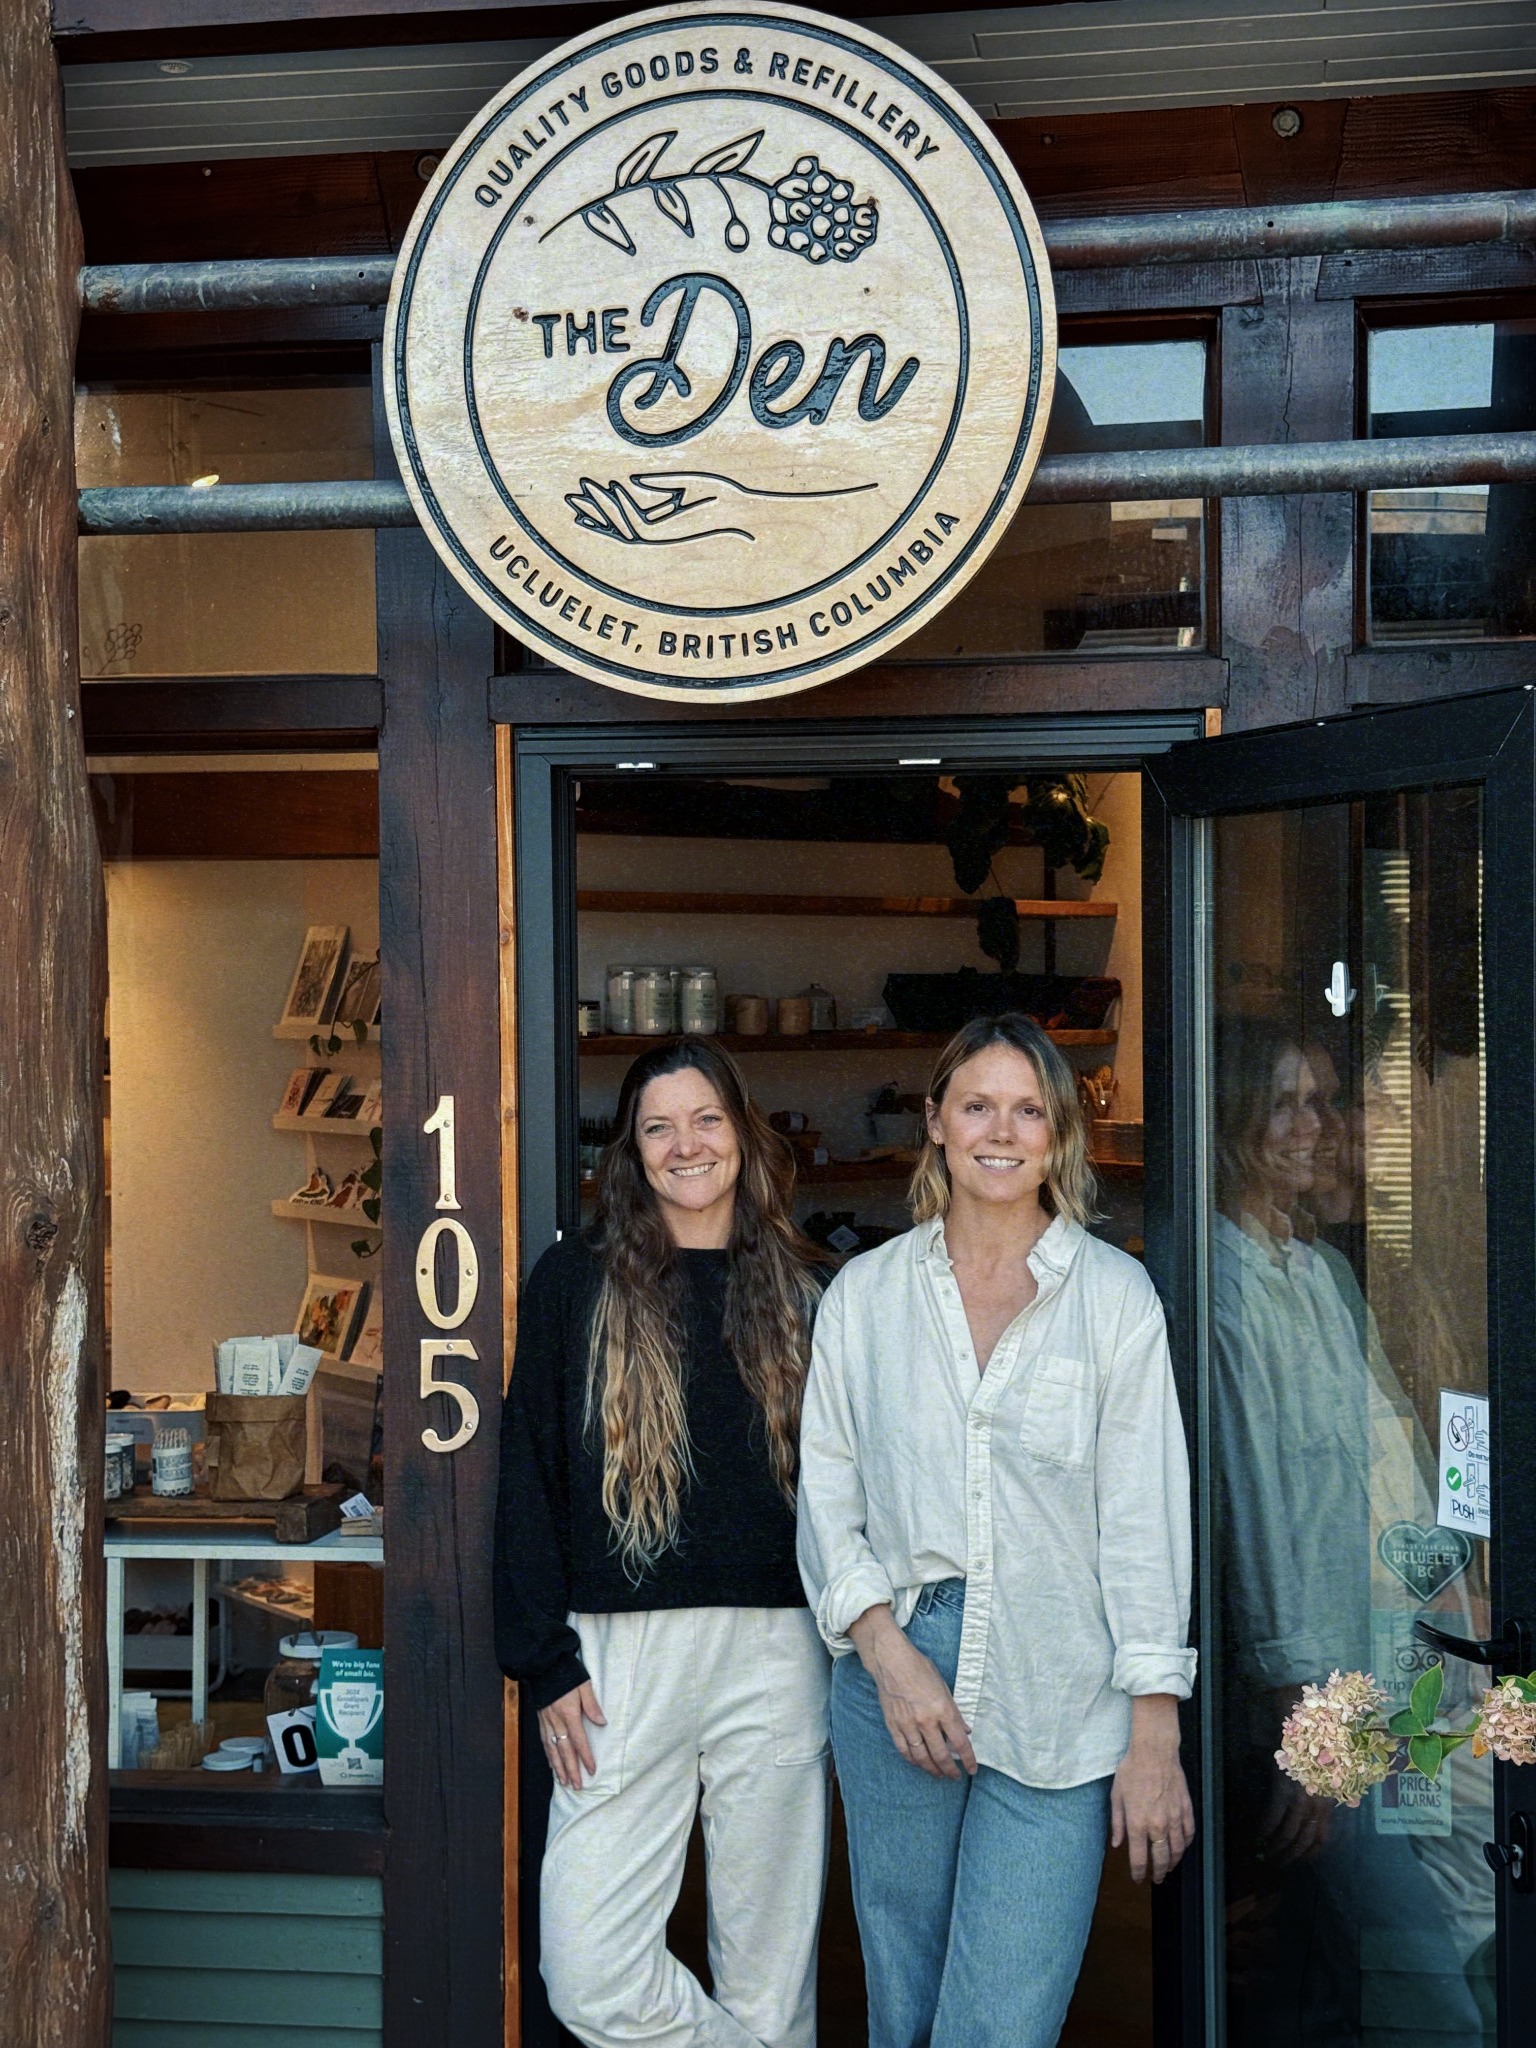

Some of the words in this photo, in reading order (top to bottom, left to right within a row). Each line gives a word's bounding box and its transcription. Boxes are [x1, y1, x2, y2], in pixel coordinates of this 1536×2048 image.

[474, 86, 594, 209] QUALITY
[601, 47, 720, 97] GOODS
[733, 48, 754, 75] &
[768, 52, 941, 163] REFILLERY
[532, 308, 631, 358] THE
[606, 272, 920, 448] Den
[490, 534, 642, 654] UCLUELET,
[658, 623, 798, 660] BRITISH
[810, 511, 960, 637] COLUMBIA
[1451, 1499, 1475, 1520] PUSH
[1393, 1550, 1459, 1566] UCLUELET
[1417, 1565, 1434, 1578] BC
[353, 1660, 365, 1669] big
[335, 1669, 344, 1677] of
[1400, 1775, 1442, 1792] PRICES
[1400, 1794, 1442, 1808] ALARMS
